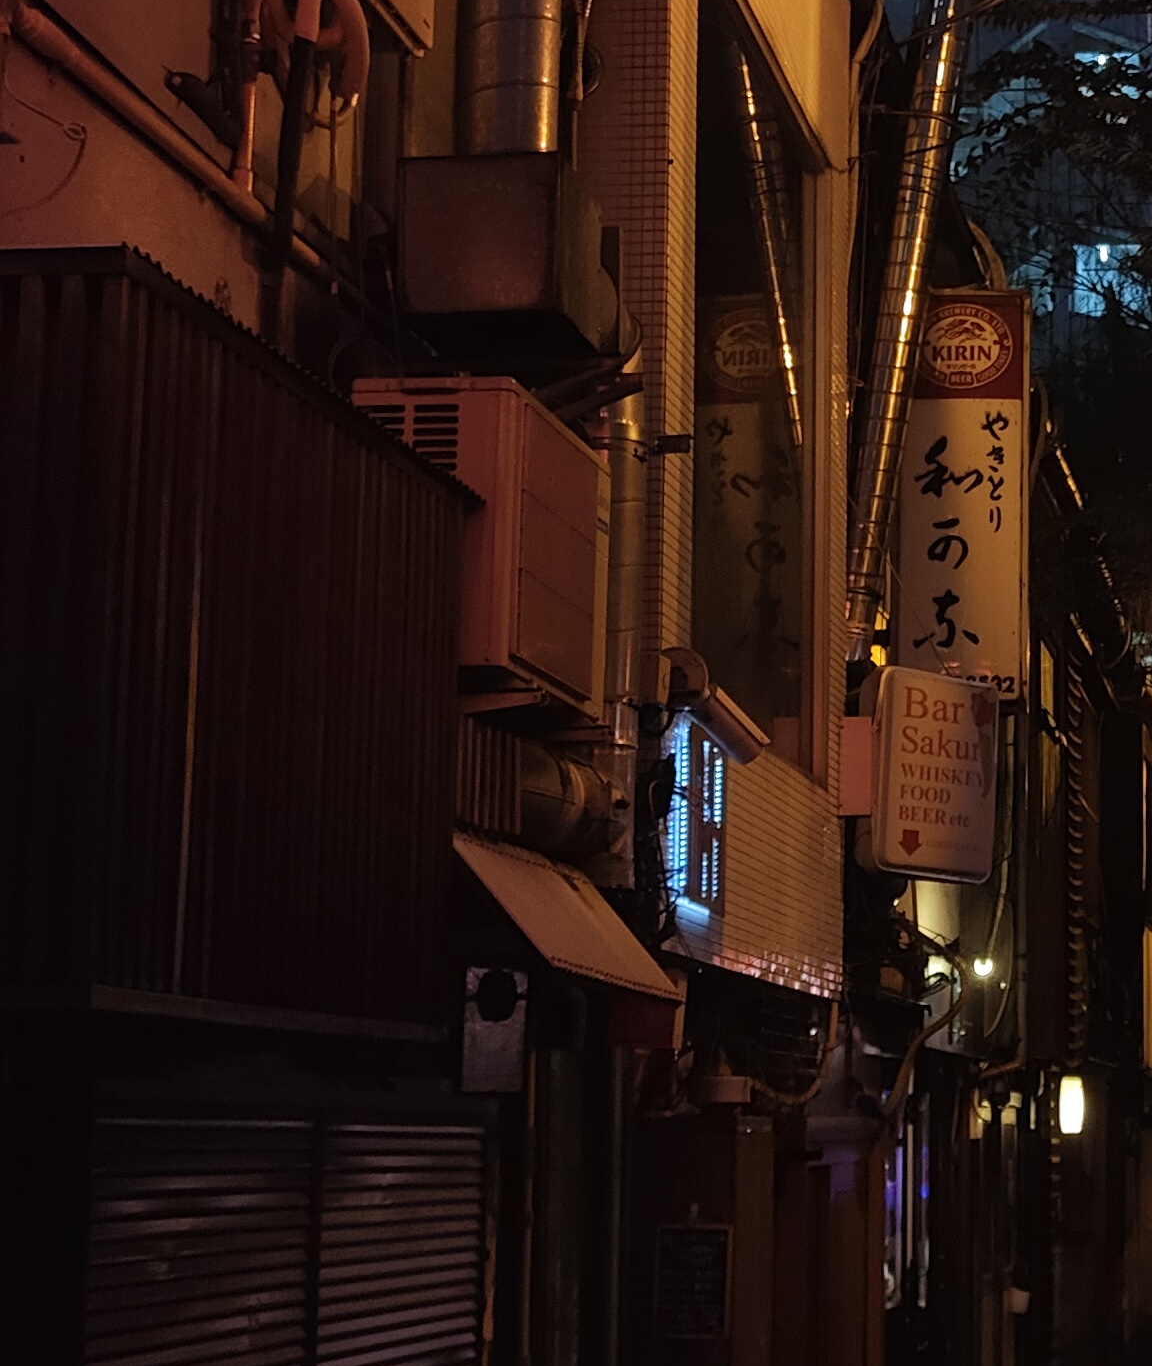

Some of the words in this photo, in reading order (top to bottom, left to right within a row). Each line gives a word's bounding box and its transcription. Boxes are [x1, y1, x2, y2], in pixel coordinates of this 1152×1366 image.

[932, 345, 992, 362] KIRIN
[950, 374, 973, 384] BEER
[981, 411, 1009, 533] やきとり
[904, 686, 965, 724] Bar
[899, 784, 951, 805] FOOD
[898, 805, 948, 825] BEER
[949, 814, 970, 829] etc
